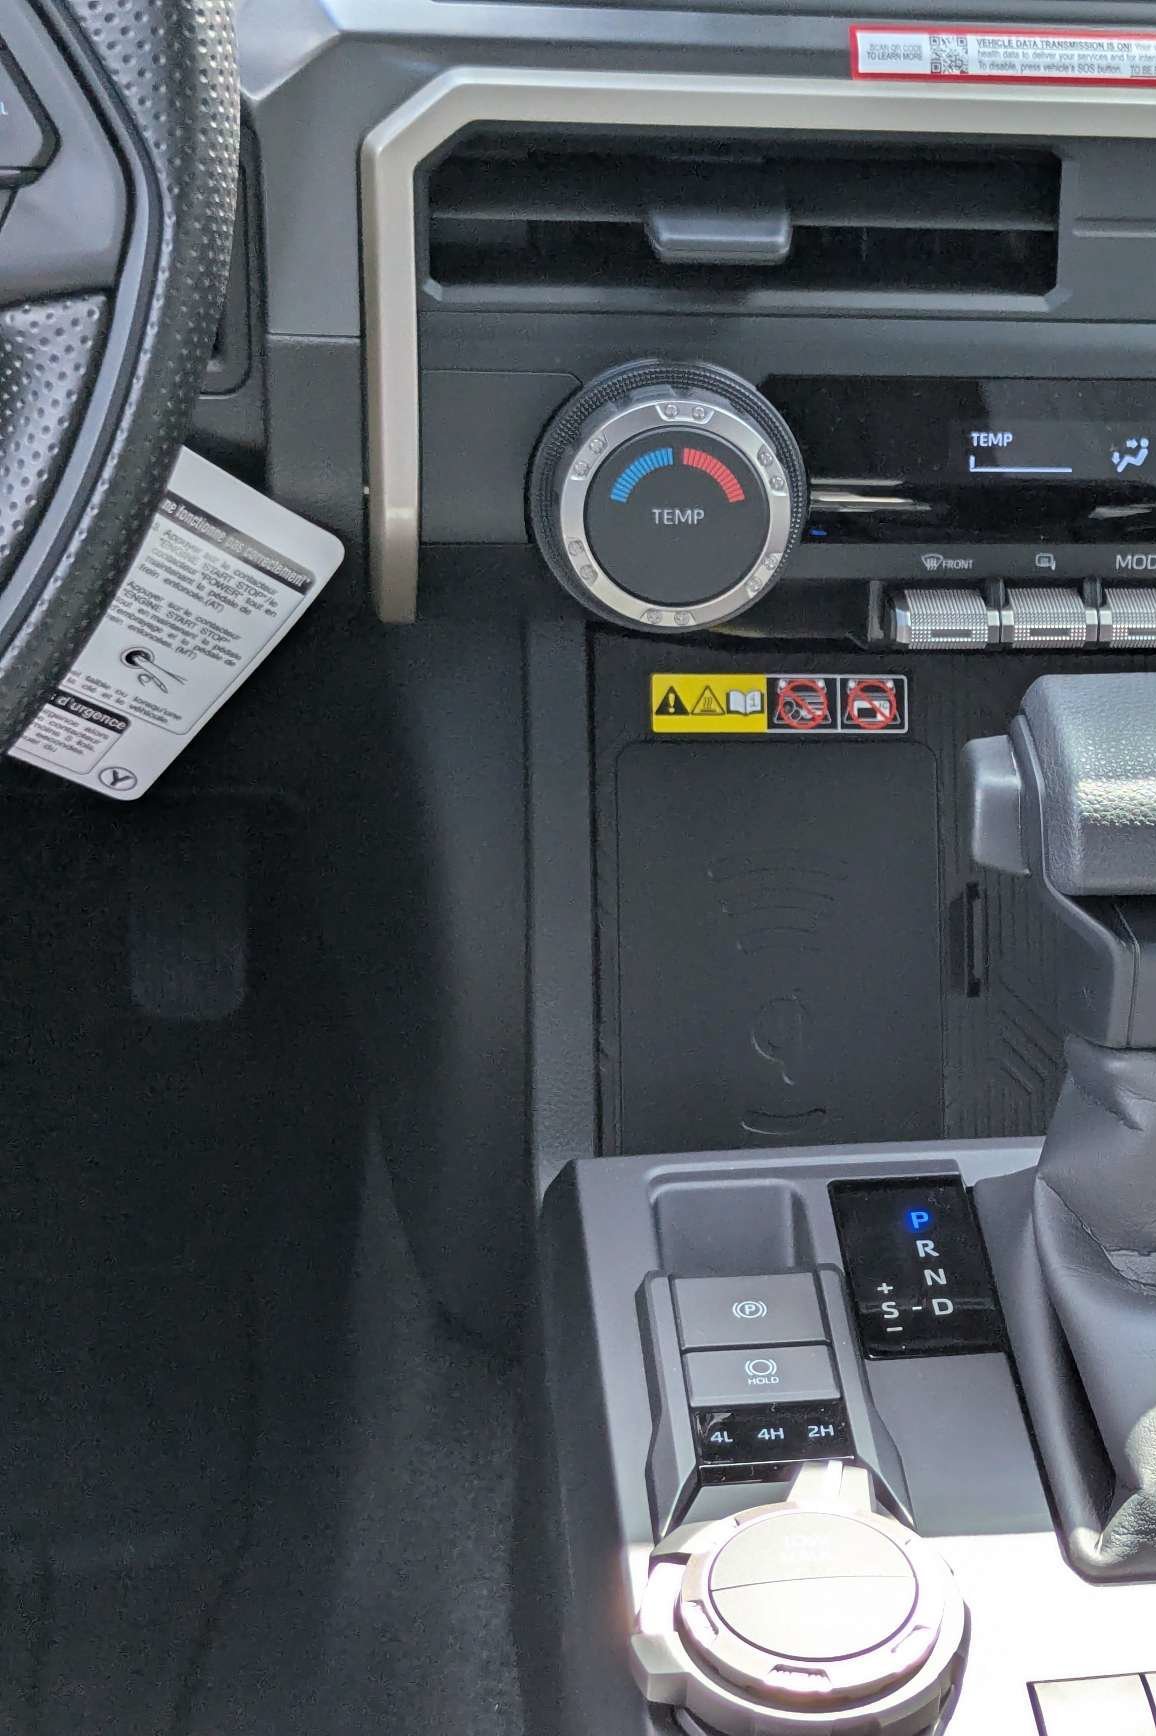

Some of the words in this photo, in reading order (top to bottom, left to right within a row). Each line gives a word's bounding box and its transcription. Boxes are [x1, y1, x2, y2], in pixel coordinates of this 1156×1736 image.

[977, 38, 1013, 48] VEHICLE
[1016, 39, 1038, 49] DATA
[1041, 39, 1105, 51] TRANSMISSION
[1106, 41, 1116, 51] IS
[867, 51, 877, 60] TO
[878, 52, 901, 60] LEARN
[902, 52, 923, 61] MORE
[977, 50, 1000, 59] health
[1003, 50, 1020, 59] data
[1022, 51, 1030, 59] to
[1032, 52, 1056, 60] deliver
[1059, 54, 1075, 62] your
[1077, 53, 1108, 61] services
[1110, 53, 1125, 61] and
[979, 61, 988, 69] To
[1020, 64, 1041, 72] press
[1043, 63, 1075, 72] vehicle's
[1077, 64, 1096, 73] SOS
[1130, 65, 1140, 75] TO
[1142, 65, 1152, 75] BE
[971, 431, 1013, 447] TEMP
[174, 504, 227, 542] fonctionne
[652, 508, 705, 525] TEMP
[201, 562, 234, 584] START
[942, 559, 973, 570] FRONT
[232, 567, 279, 596] contacteur
[199, 572, 244, 600] "POWER"
[245, 596, 264, 611] tout
[165, 609, 197, 630] START
[56, 693, 126, 730] d'urgence
[910, 1211, 929, 1229] P
[915, 1239, 940, 1258] R
[923, 1268, 947, 1286] N
[881, 1301, 900, 1319] S
[931, 1298, 954, 1316] D
[747, 1376, 780, 1385] HOLD
[709, 1430, 734, 1443] 4L
[757, 1427, 785, 1440] 4H
[807, 1424, 835, 1438] 2H
